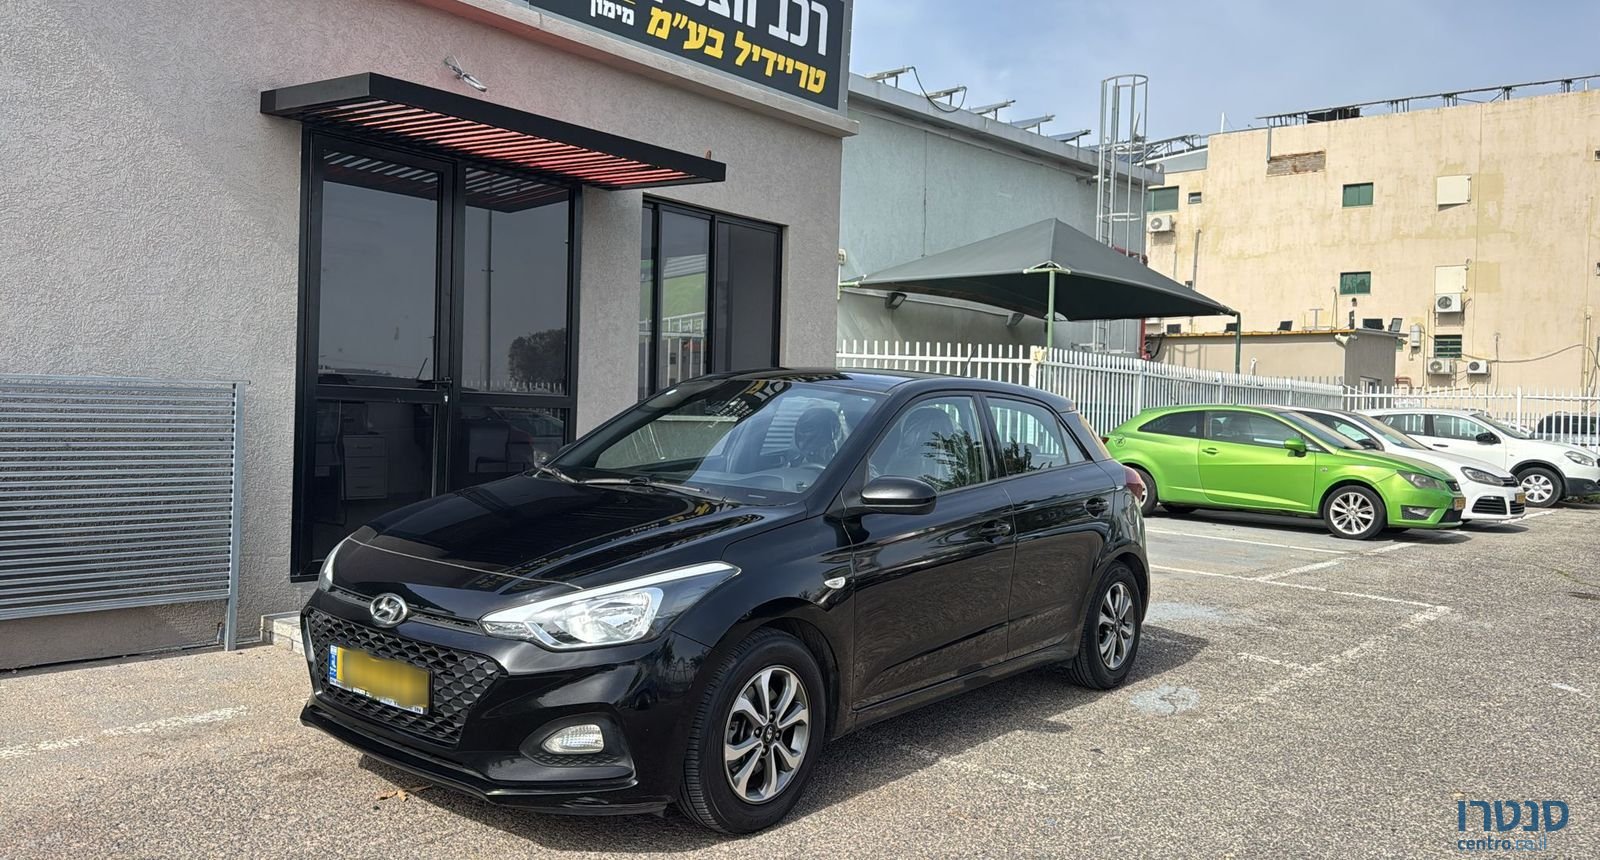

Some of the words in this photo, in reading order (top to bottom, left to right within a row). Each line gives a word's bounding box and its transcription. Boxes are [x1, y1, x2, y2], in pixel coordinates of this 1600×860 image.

[590, 0, 635, 26] מימון
[768, 0, 829, 56] רכב
[734, 30, 827, 94] טריידיל
